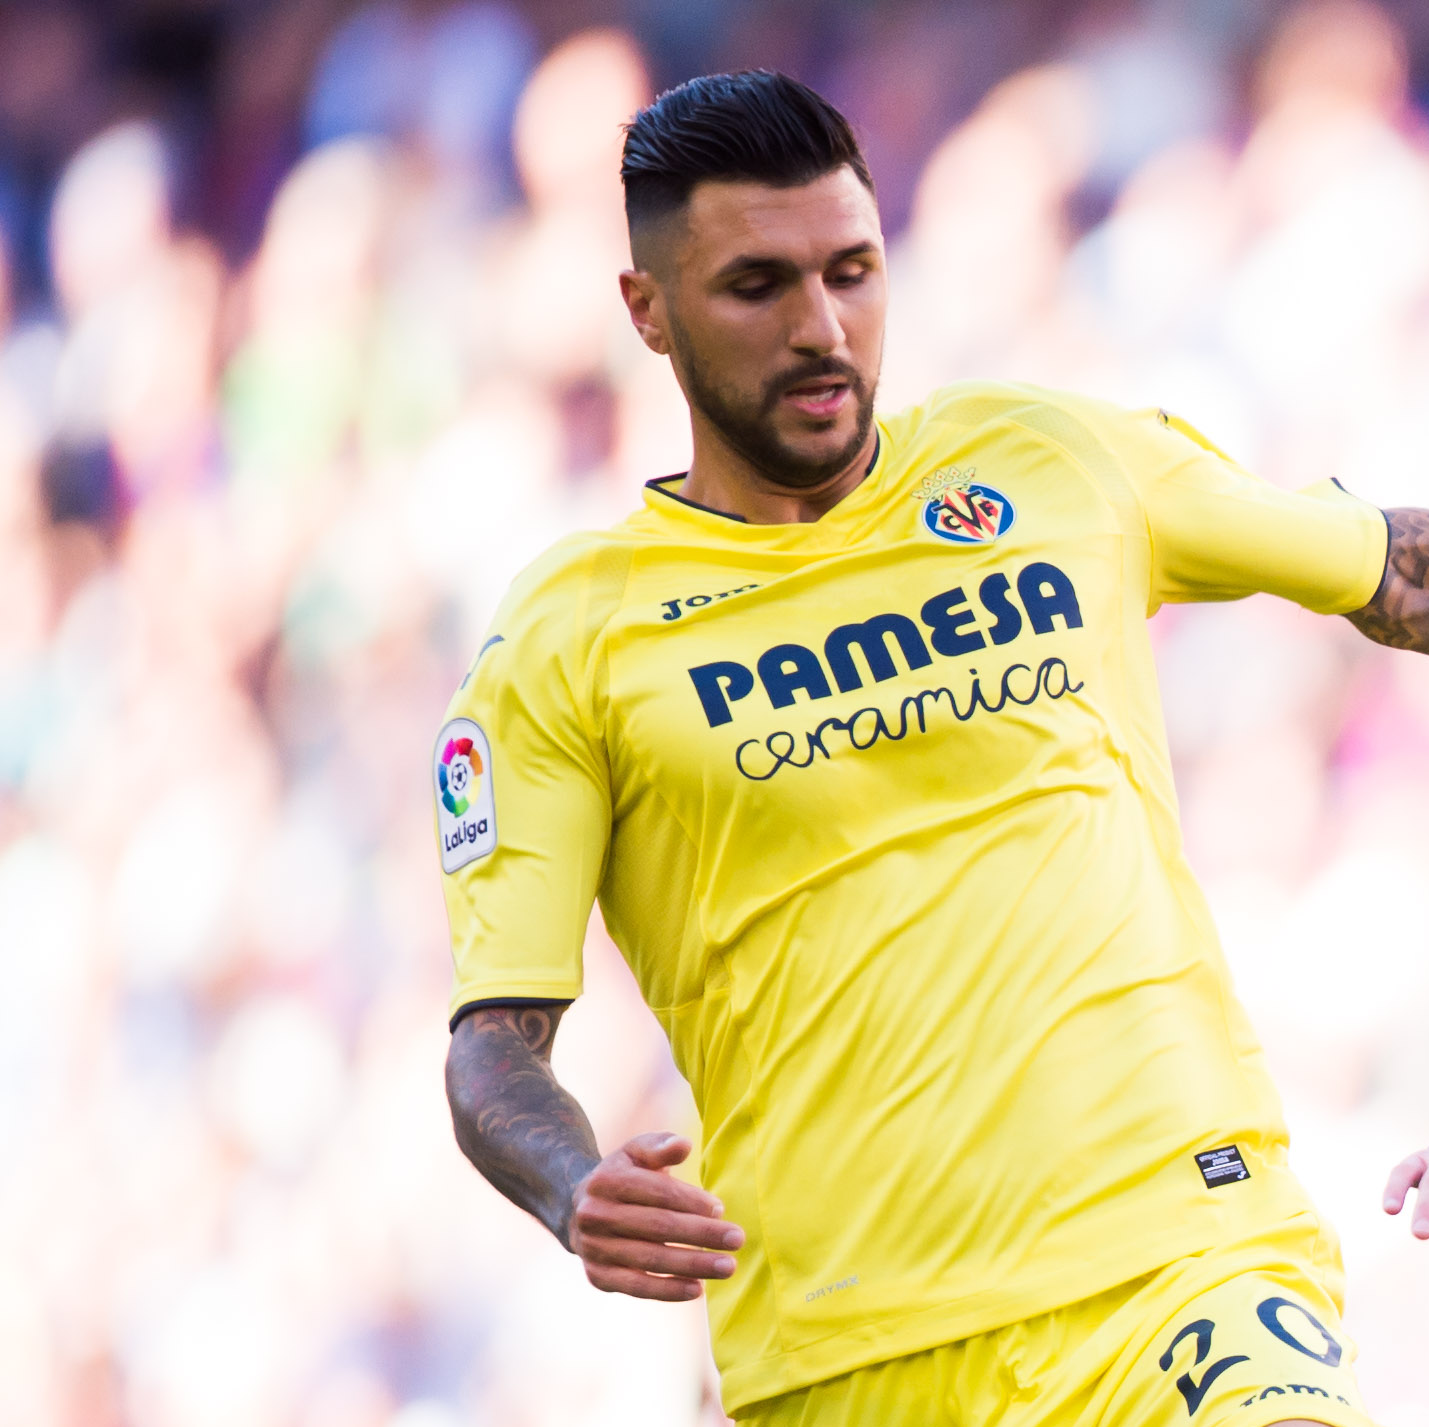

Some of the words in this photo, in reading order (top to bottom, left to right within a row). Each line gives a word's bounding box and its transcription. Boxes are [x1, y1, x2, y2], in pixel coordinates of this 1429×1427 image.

[688, 563, 1083, 727] PAMESA
[736, 657, 1084, 781] ceramica
[445, 818, 488, 852] LaLiga
[1159, 1297, 1342, 1417] 20
